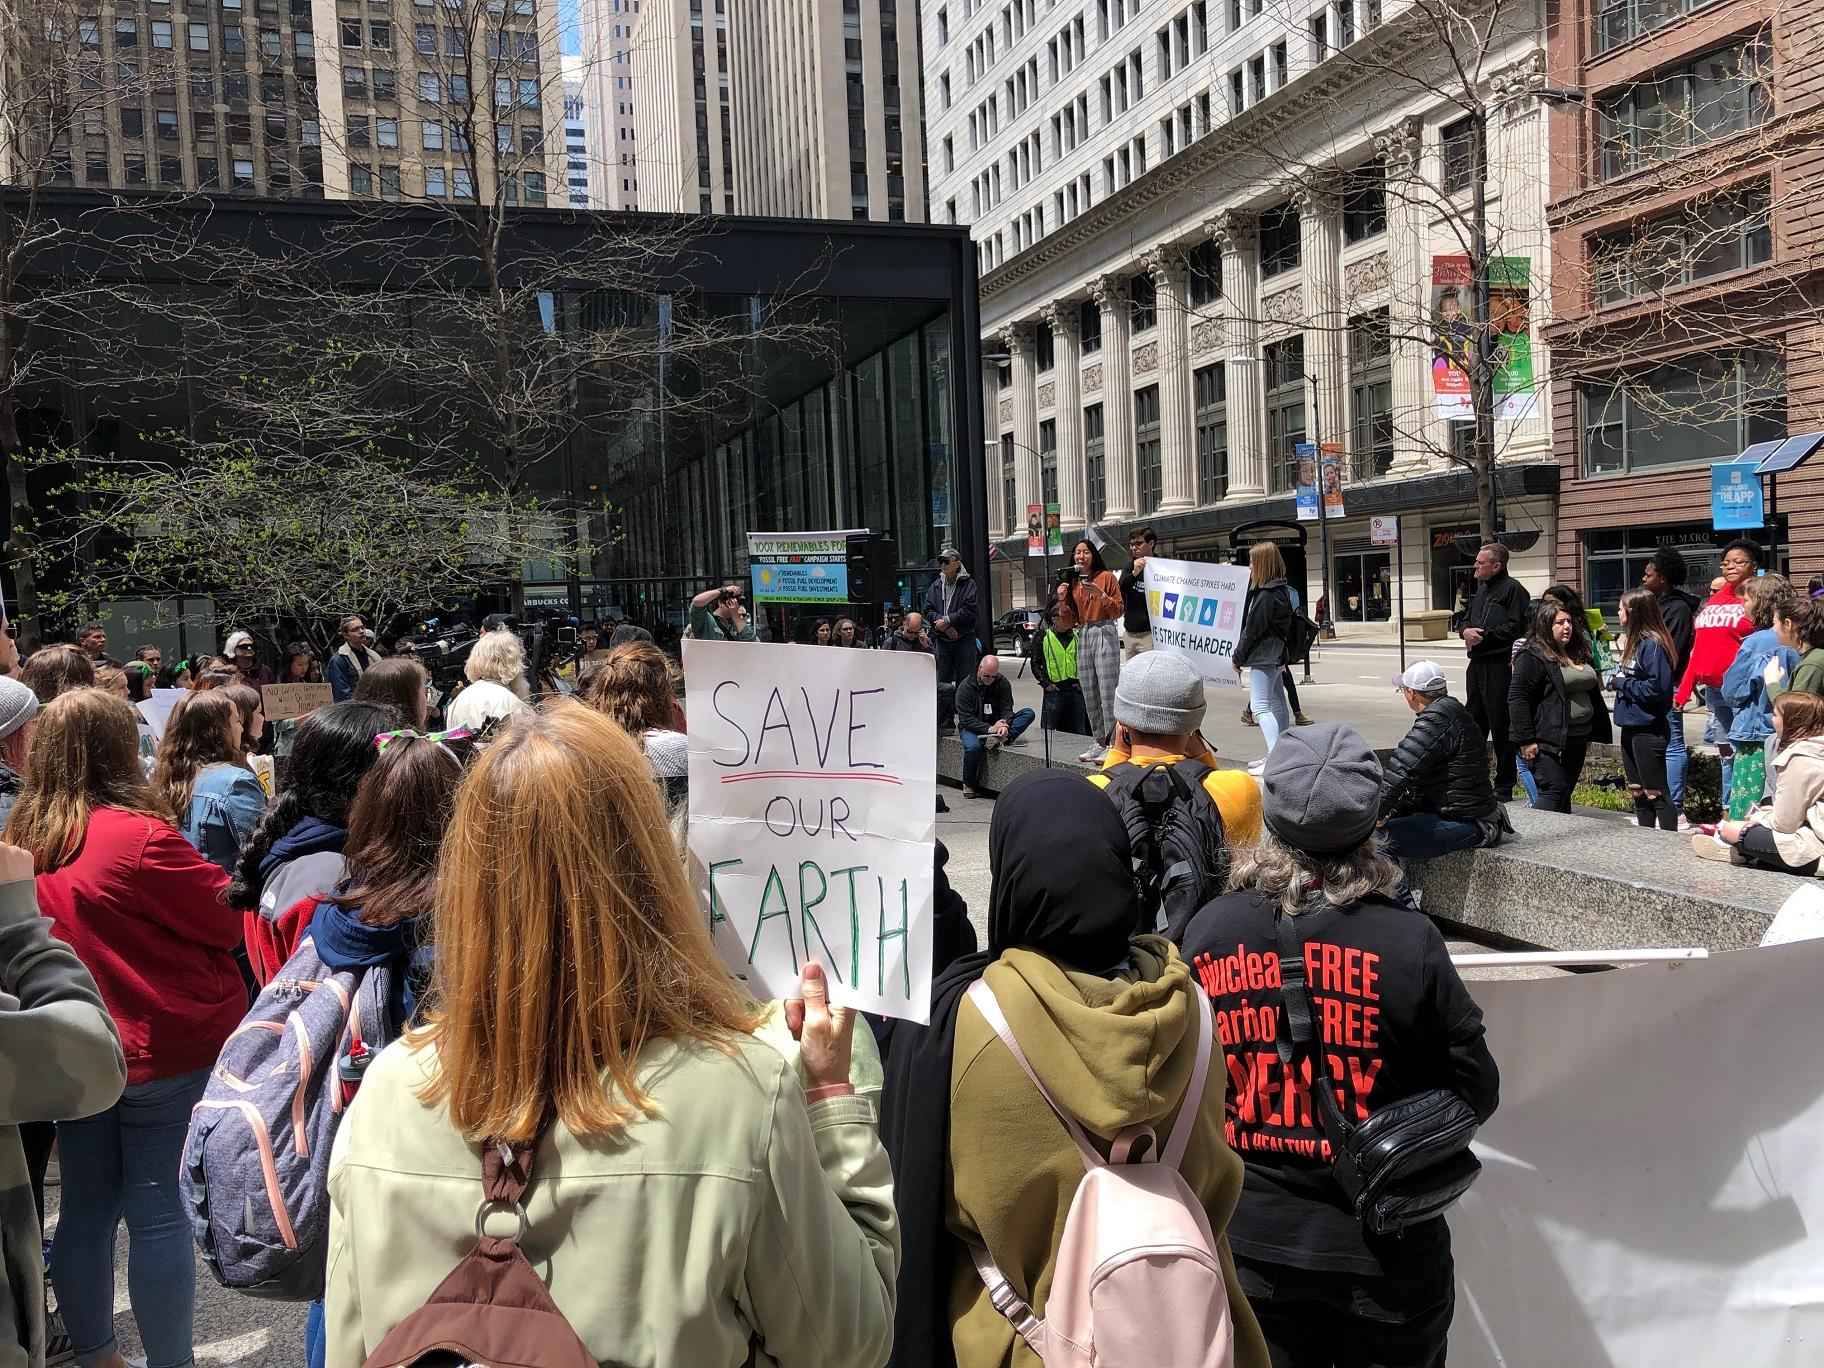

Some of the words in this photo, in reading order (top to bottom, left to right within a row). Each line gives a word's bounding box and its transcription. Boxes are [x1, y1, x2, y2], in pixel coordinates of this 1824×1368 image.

[1733, 490, 1754, 503] APP
[776, 540, 829, 552] RENEWABLES
[1656, 535, 1675, 544] THE
[1680, 533, 1710, 543] MARQ
[1154, 574, 1176, 584] CLIMATE
[1177, 577, 1199, 587] CHANGE
[1200, 579, 1220, 590] STRIKES
[1221, 581, 1236, 591] HARD
[1160, 627, 1186, 648] STRIKE
[712, 680, 885, 768] SAVE
[765, 796, 858, 841] OUR
[709, 858, 911, 1000] EARTH
[1194, 944, 1283, 998] Nuclea
[1304, 942, 1380, 1001] FREE
[1218, 998, 1280, 1046] arbo
[1225, 1052, 1383, 1128] NERGY
[1241, 1132, 1248, 1150] A
[1253, 1128, 1316, 1159] HEALTHY
